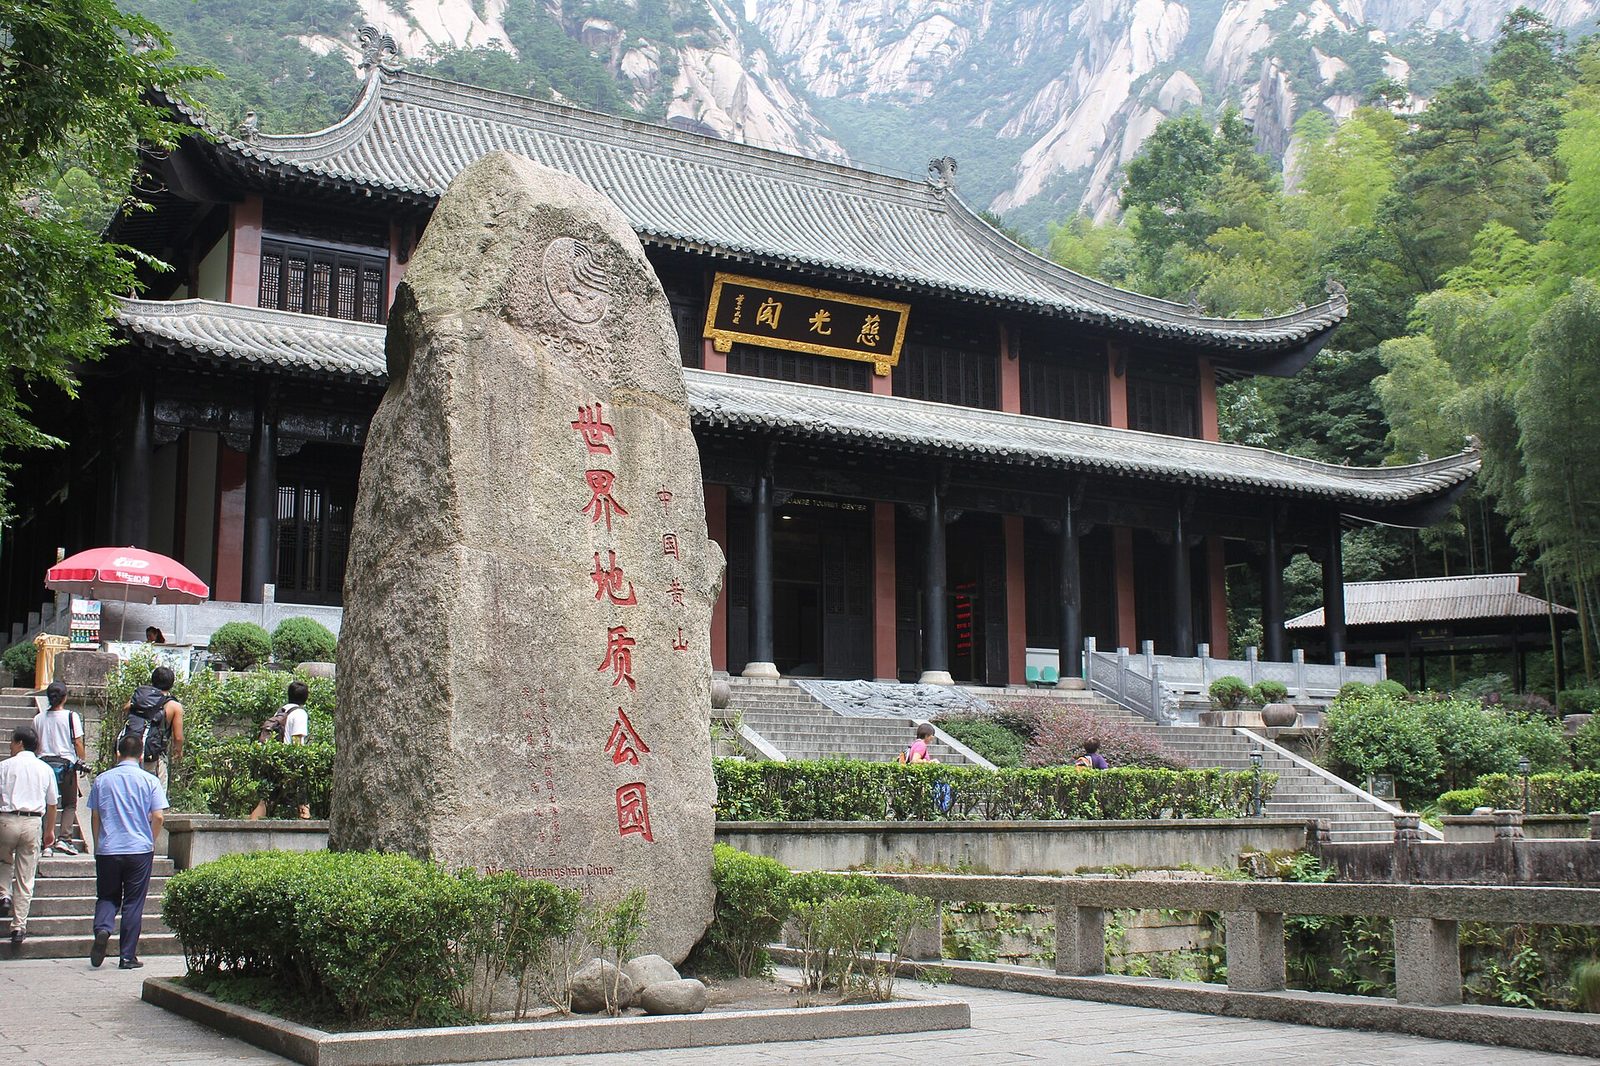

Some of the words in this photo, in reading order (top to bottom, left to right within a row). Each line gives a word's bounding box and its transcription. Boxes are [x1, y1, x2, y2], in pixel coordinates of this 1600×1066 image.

[571, 402, 654, 842] 世界地质公园
[527, 865, 584, 879] Huangshan
[587, 864, 614, 876] China
